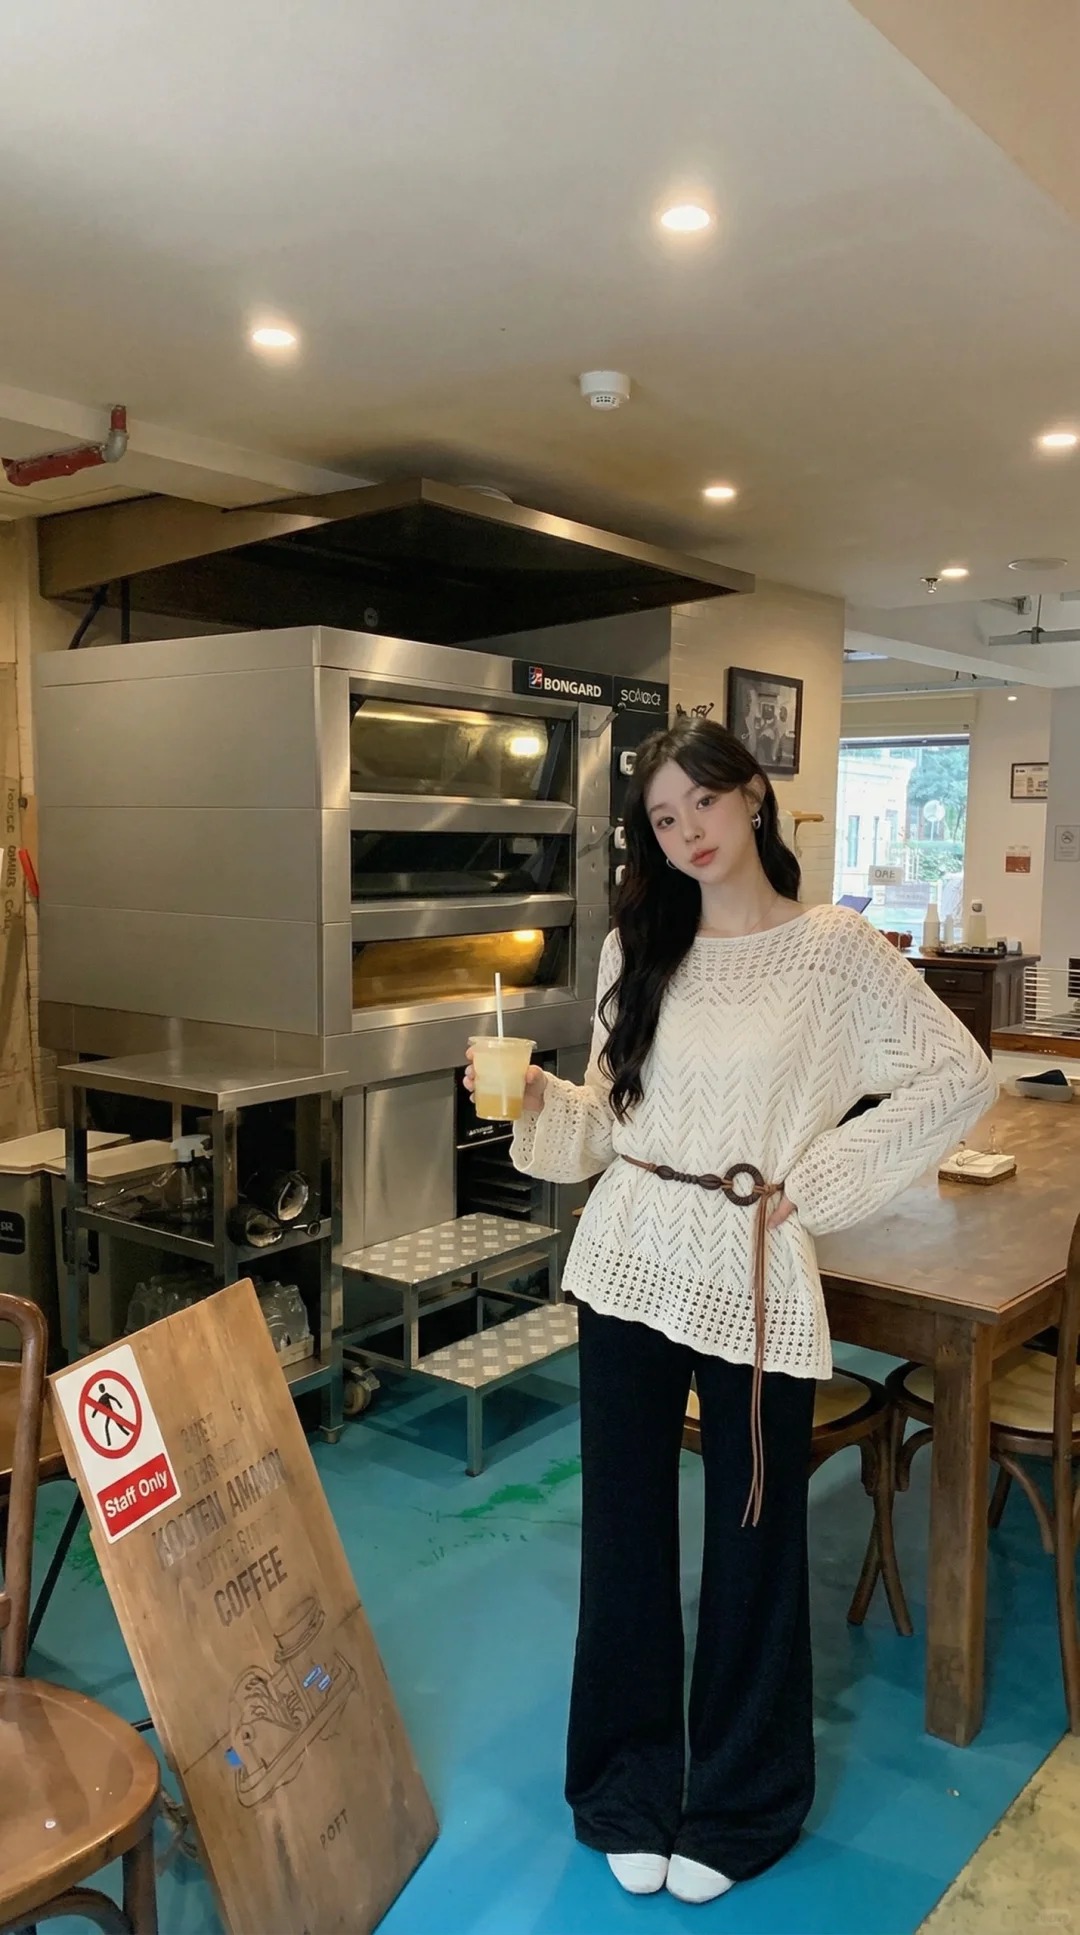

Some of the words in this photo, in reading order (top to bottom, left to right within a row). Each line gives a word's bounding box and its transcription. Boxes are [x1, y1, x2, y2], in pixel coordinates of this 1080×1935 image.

[544, 677, 602, 698] BONGARD
[104, 1485, 137, 1518] Staff
[138, 1470, 168, 1497] Only
[213, 1545, 288, 1628] COFFEE
